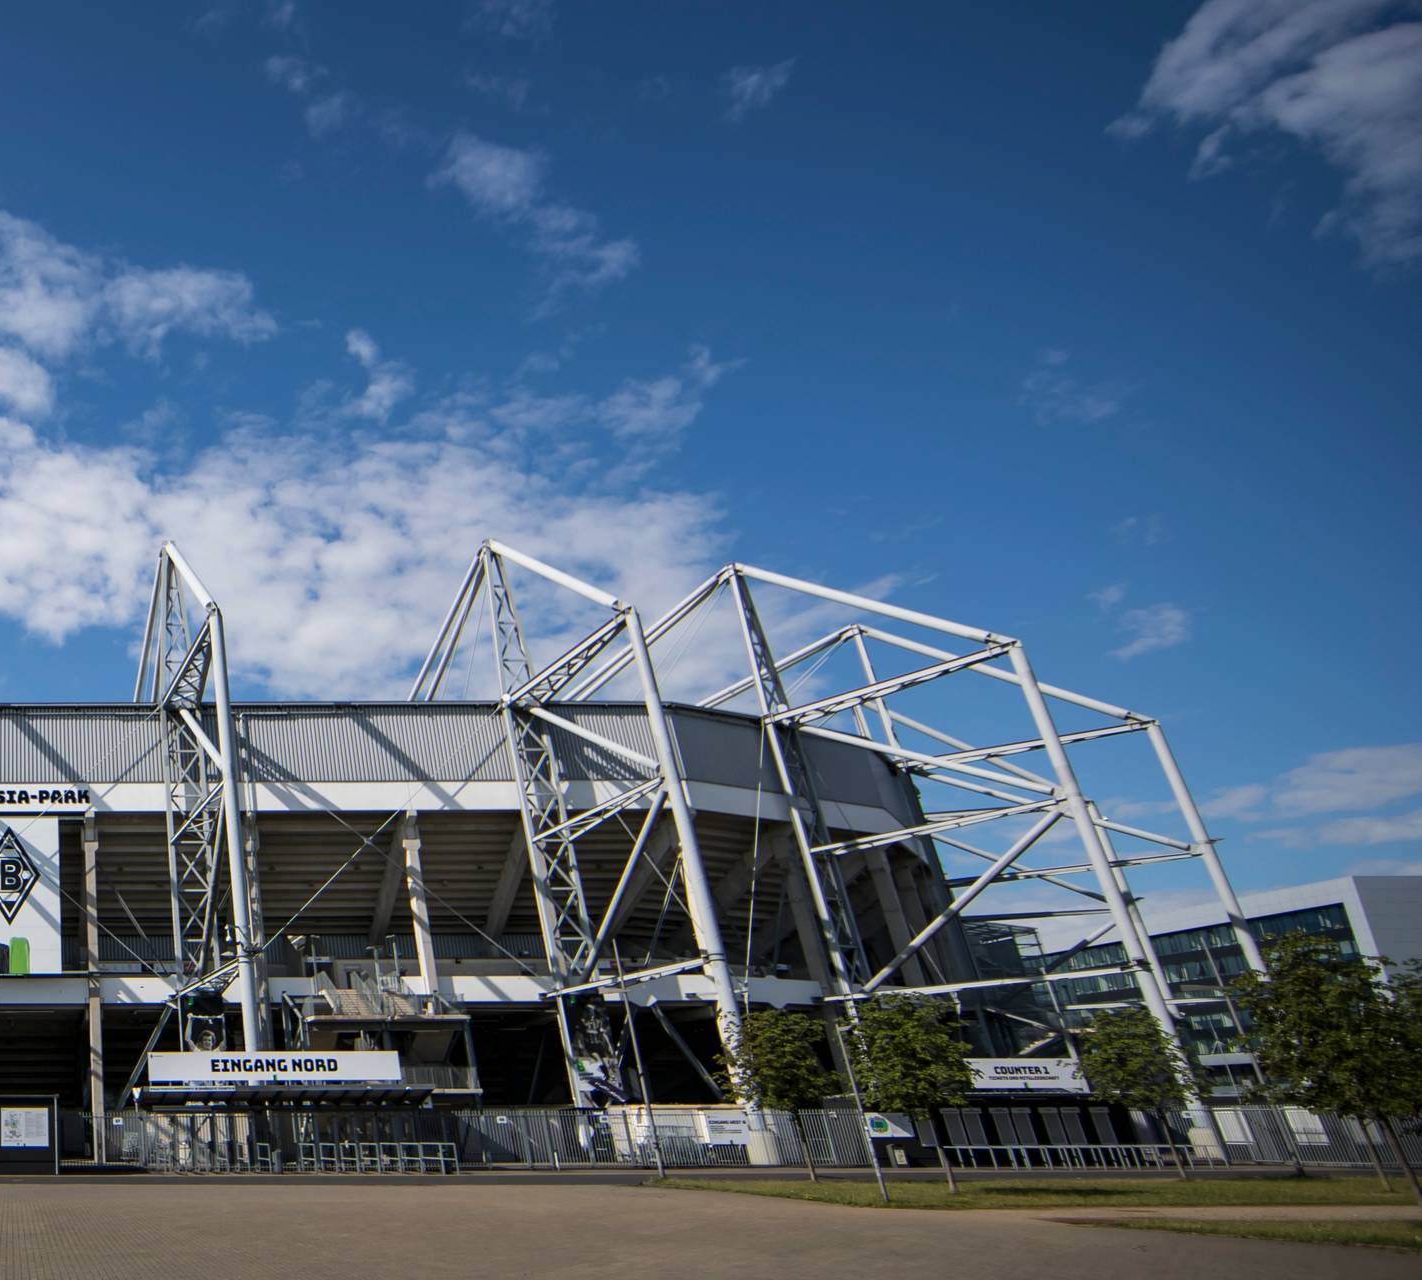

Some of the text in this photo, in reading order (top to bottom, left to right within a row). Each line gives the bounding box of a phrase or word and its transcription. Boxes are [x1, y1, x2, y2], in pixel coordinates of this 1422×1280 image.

[211, 1058, 338, 1073] EINGANG NORD
[994, 1066, 1050, 1074] COUNTER 1
